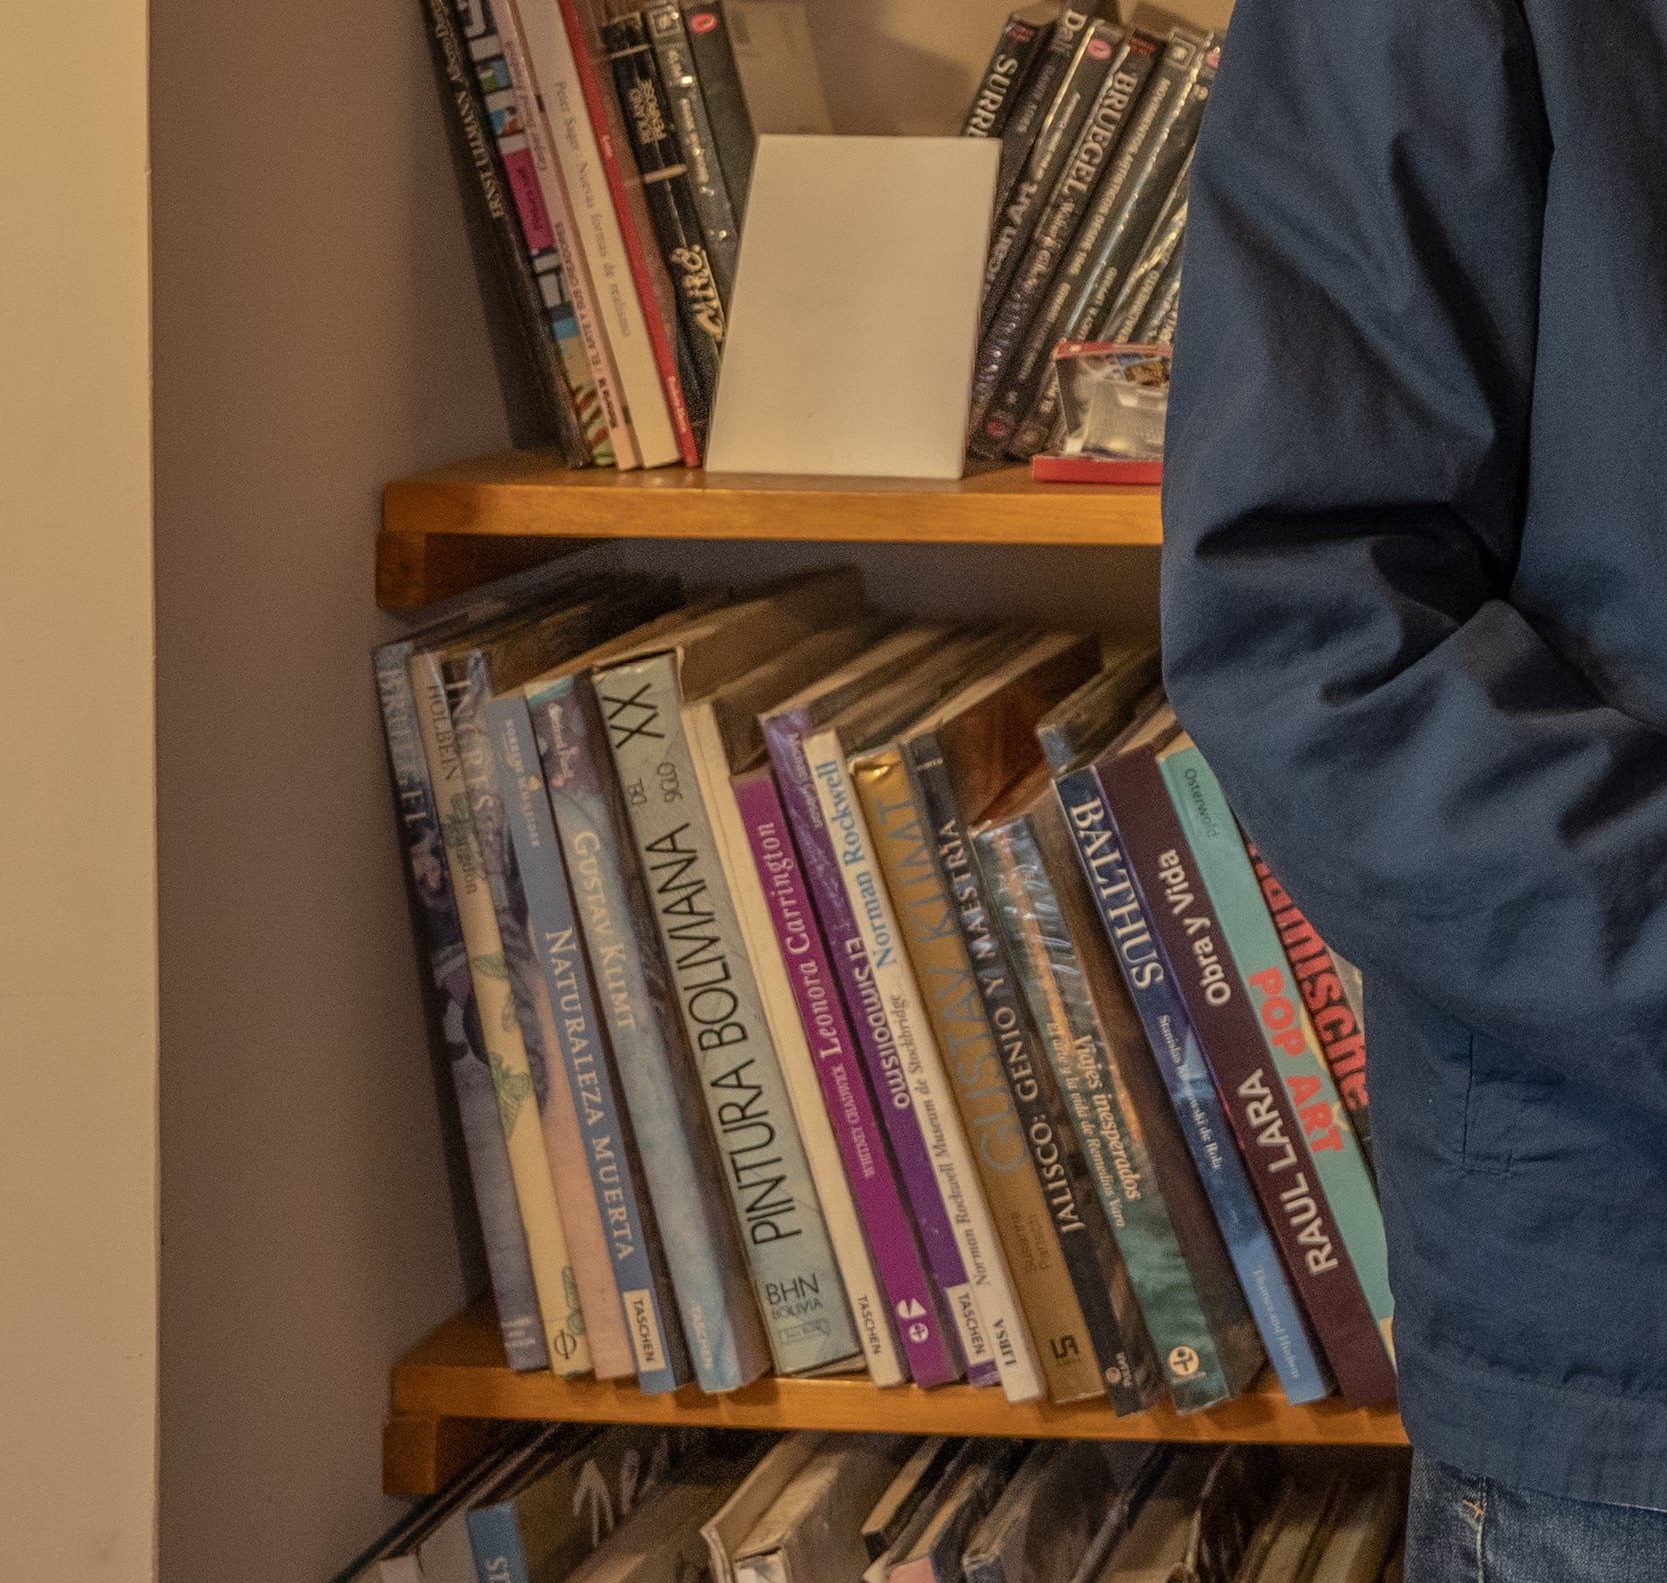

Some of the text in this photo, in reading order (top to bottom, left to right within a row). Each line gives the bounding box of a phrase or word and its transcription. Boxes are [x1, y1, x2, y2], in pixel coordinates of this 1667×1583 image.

[603, 261, 617, 277] de
[425, 683, 461, 781] HOLBEIN
[601, 682, 665, 748] XX
[571, 828, 643, 1031] GUSTAV KLIMT
[812, 758, 898, 971] Norman Rockwell
[1067, 795, 1170, 990] BALTHUS
[1151, 847, 1234, 1008] Obra y Vida
[543, 927, 638, 1261] NATURALEZA MUERTA
[641, 821, 802, 1247] PINTURA BOLIVIANA
[1245, 963, 1348, 1158] POP ART
[1072, 1032, 1145, 1204] Viajes inesperados
[1233, 1067, 1340, 1276] RAUL LARA
[632, 1298, 656, 1362] TASCHEN
[770, 1275, 820, 1306] BHN
[856, 1295, 882, 1355] TASCHEN
[956, 1291, 987, 1355] TASCHEN
[990, 1317, 1017, 1366] LIBSA
